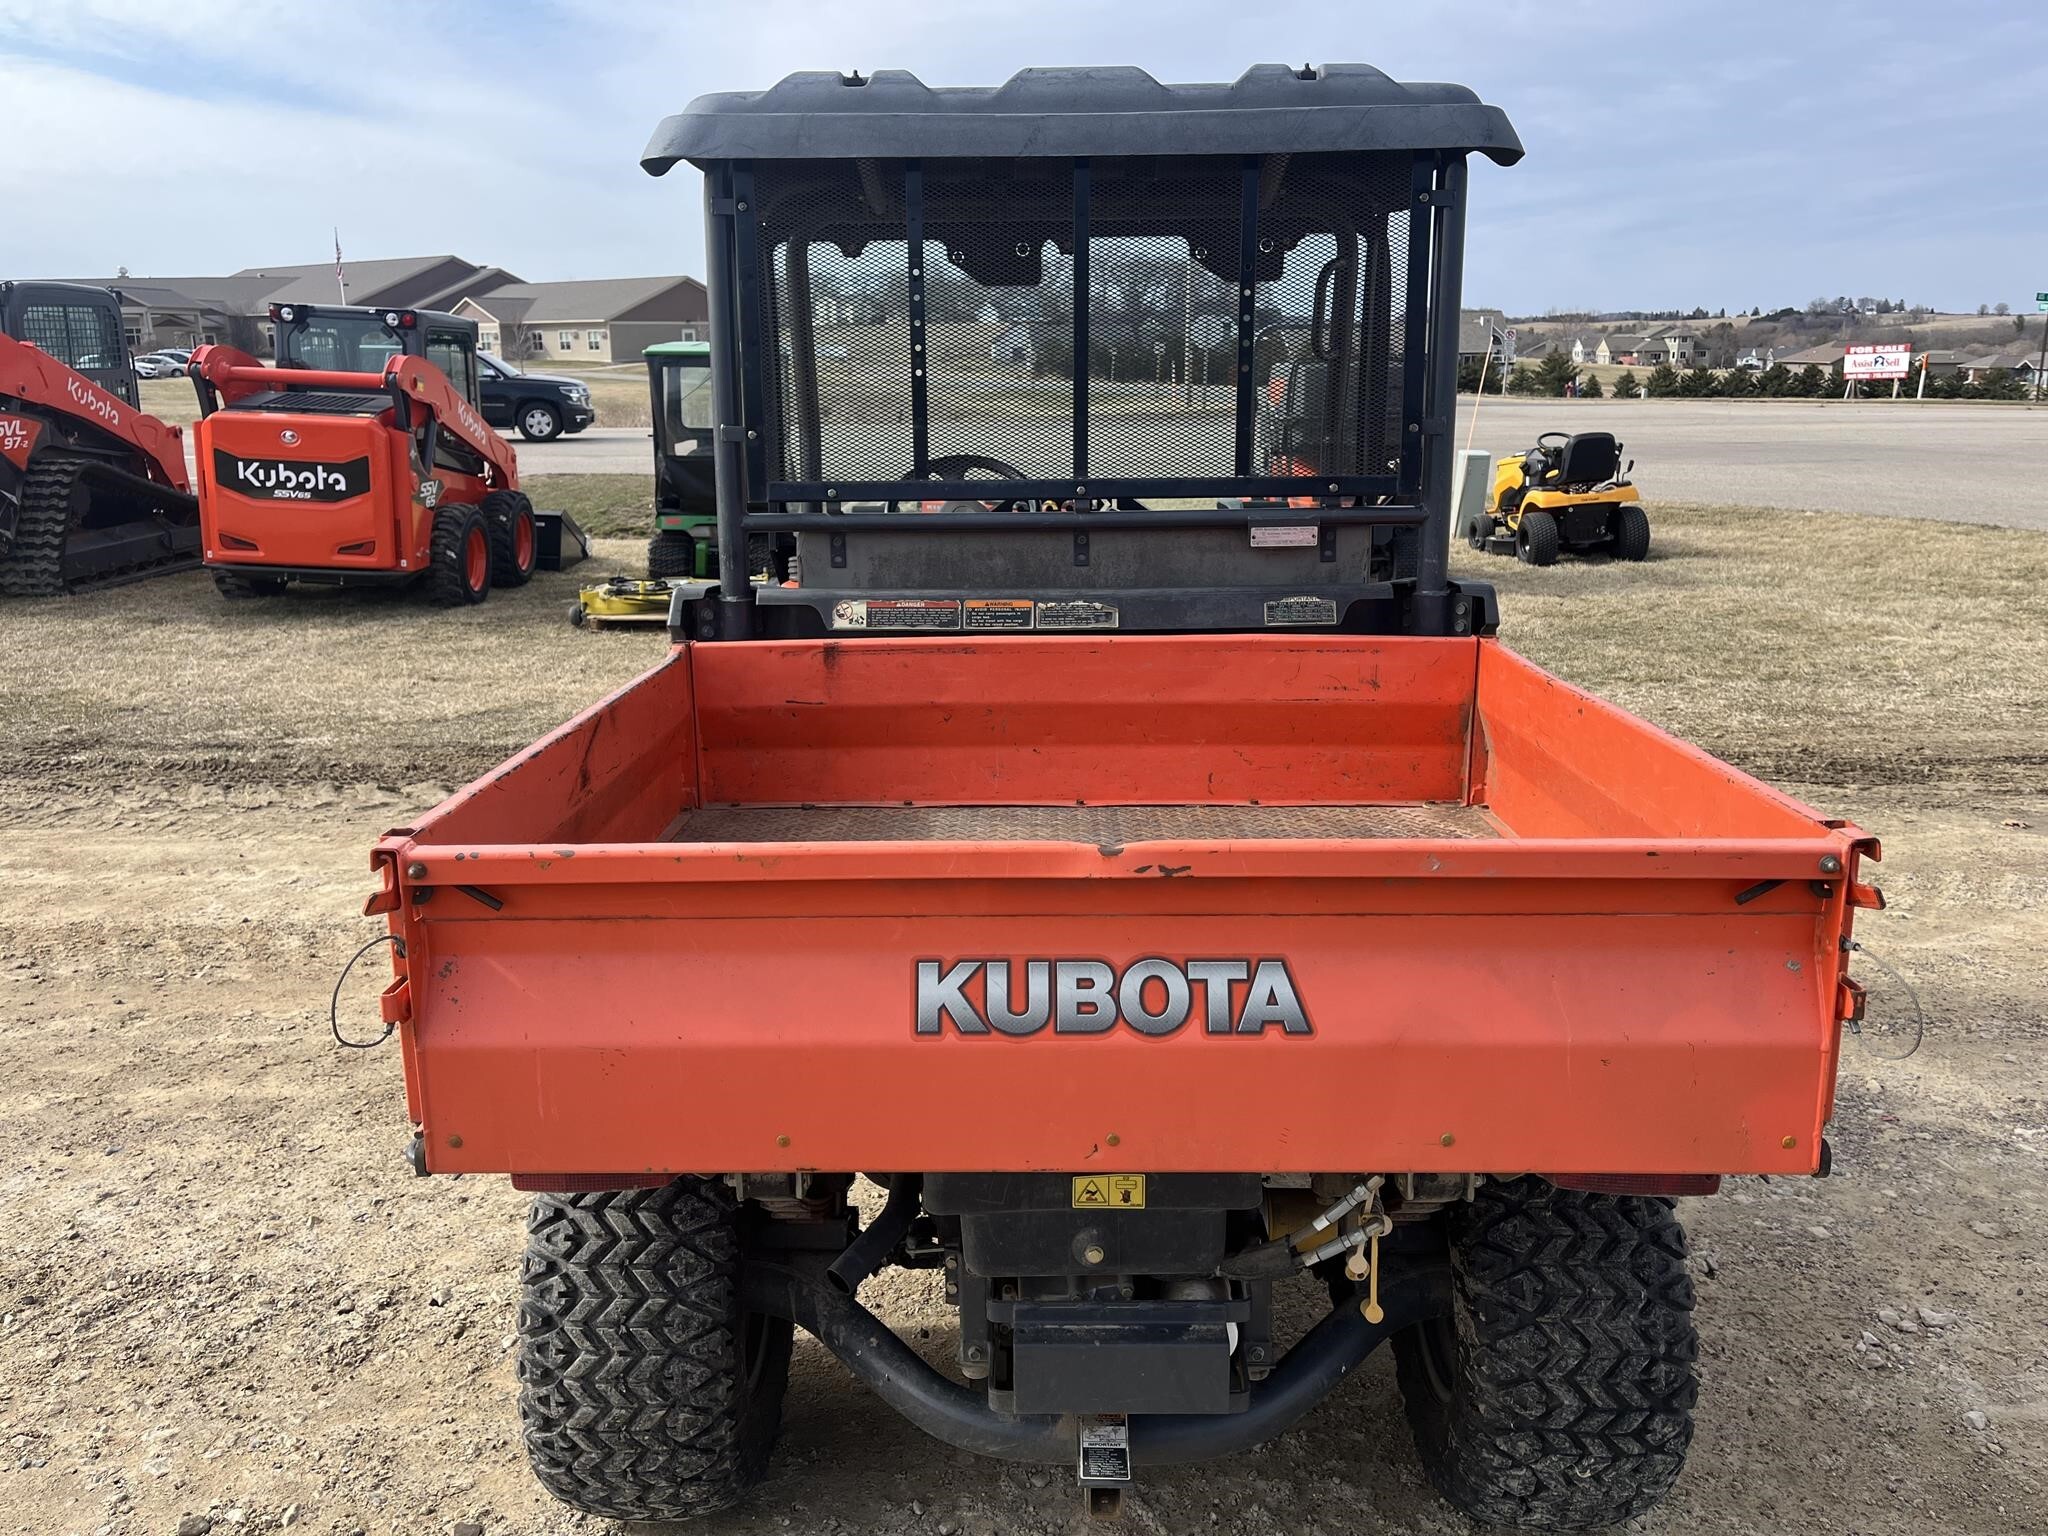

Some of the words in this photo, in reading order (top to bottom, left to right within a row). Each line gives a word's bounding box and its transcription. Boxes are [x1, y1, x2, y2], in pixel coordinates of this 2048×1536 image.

[1849, 346, 1874, 354] FOR
[1875, 344, 1905, 353] SALE
[1852, 359, 1873, 368] Assist
[1885, 358, 1900, 367] Sell
[67, 377, 119, 425] Kubota
[457, 399, 486, 444] Kubota
[237, 461, 346, 491] Kubota
[273, 489, 311, 499] SSV65
[420, 480, 438, 497] SSV
[425, 495, 436, 508] 65
[916, 959, 1311, 1035] KUBOTA
